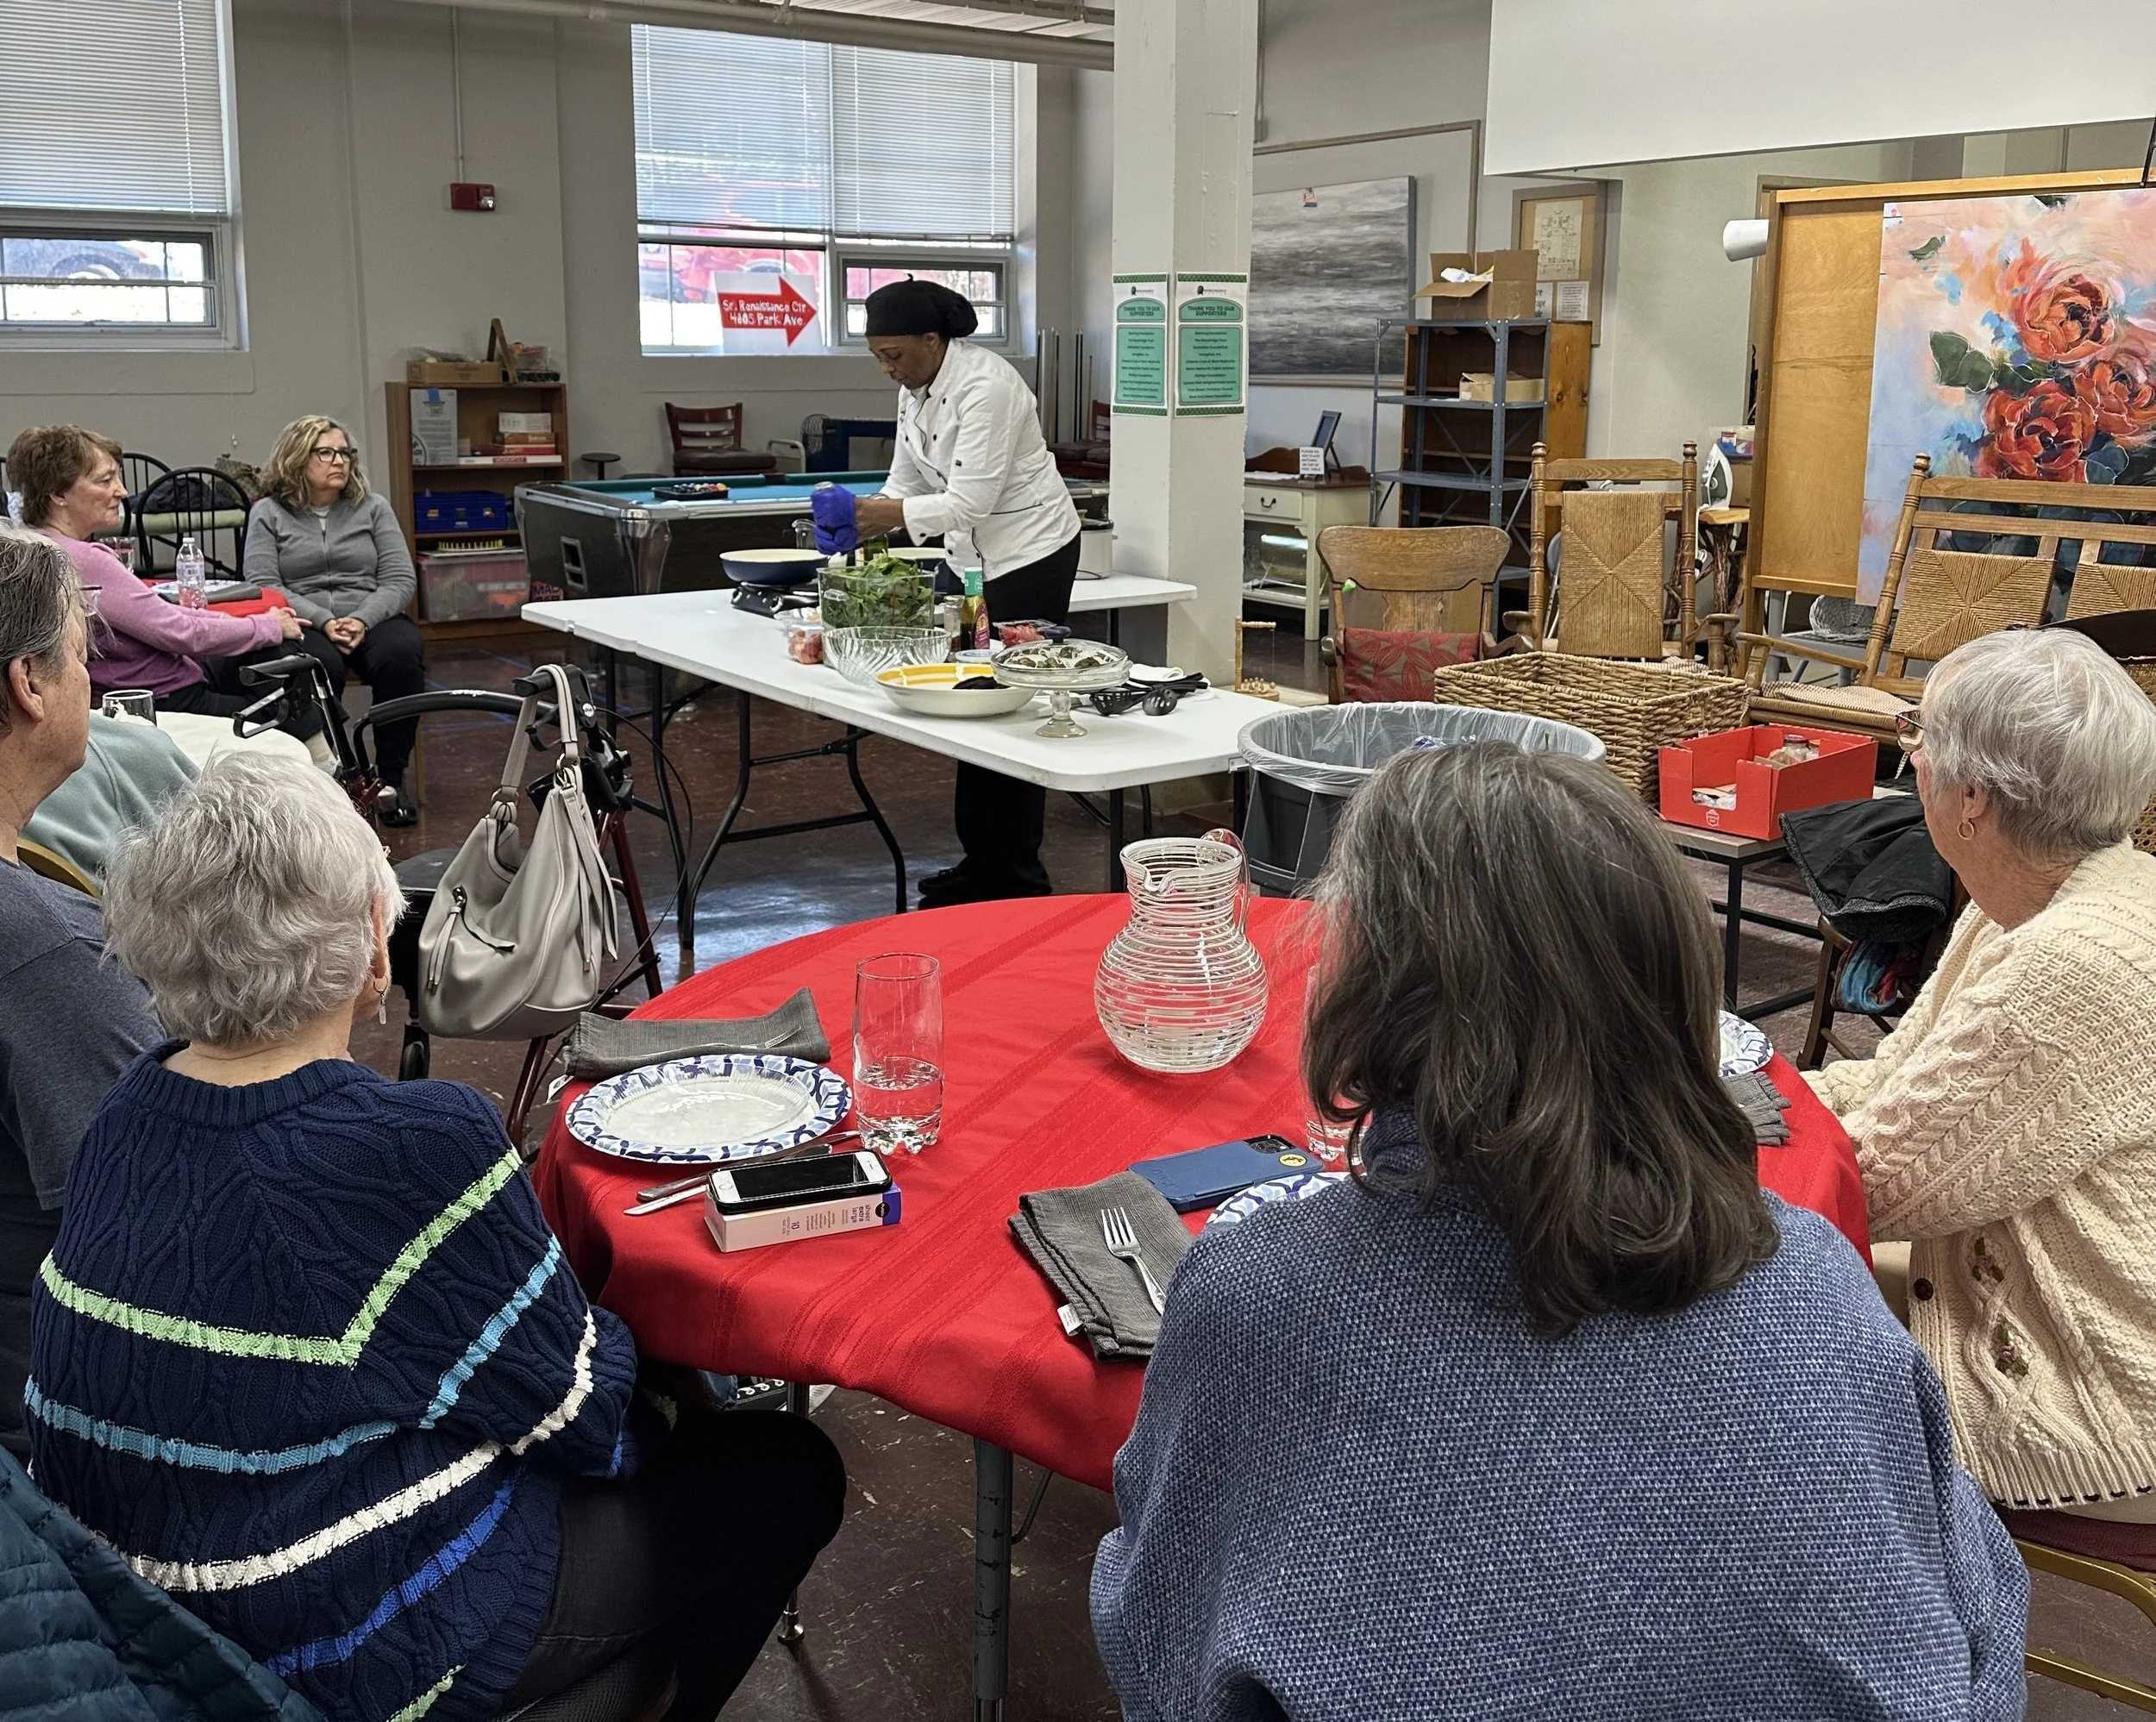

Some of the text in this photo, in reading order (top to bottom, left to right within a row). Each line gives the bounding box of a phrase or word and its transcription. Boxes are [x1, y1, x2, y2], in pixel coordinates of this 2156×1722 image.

[739, 299, 790, 312] Renaissance
[757, 312, 780, 326] Park
[791, 1221, 800, 1229] 10
